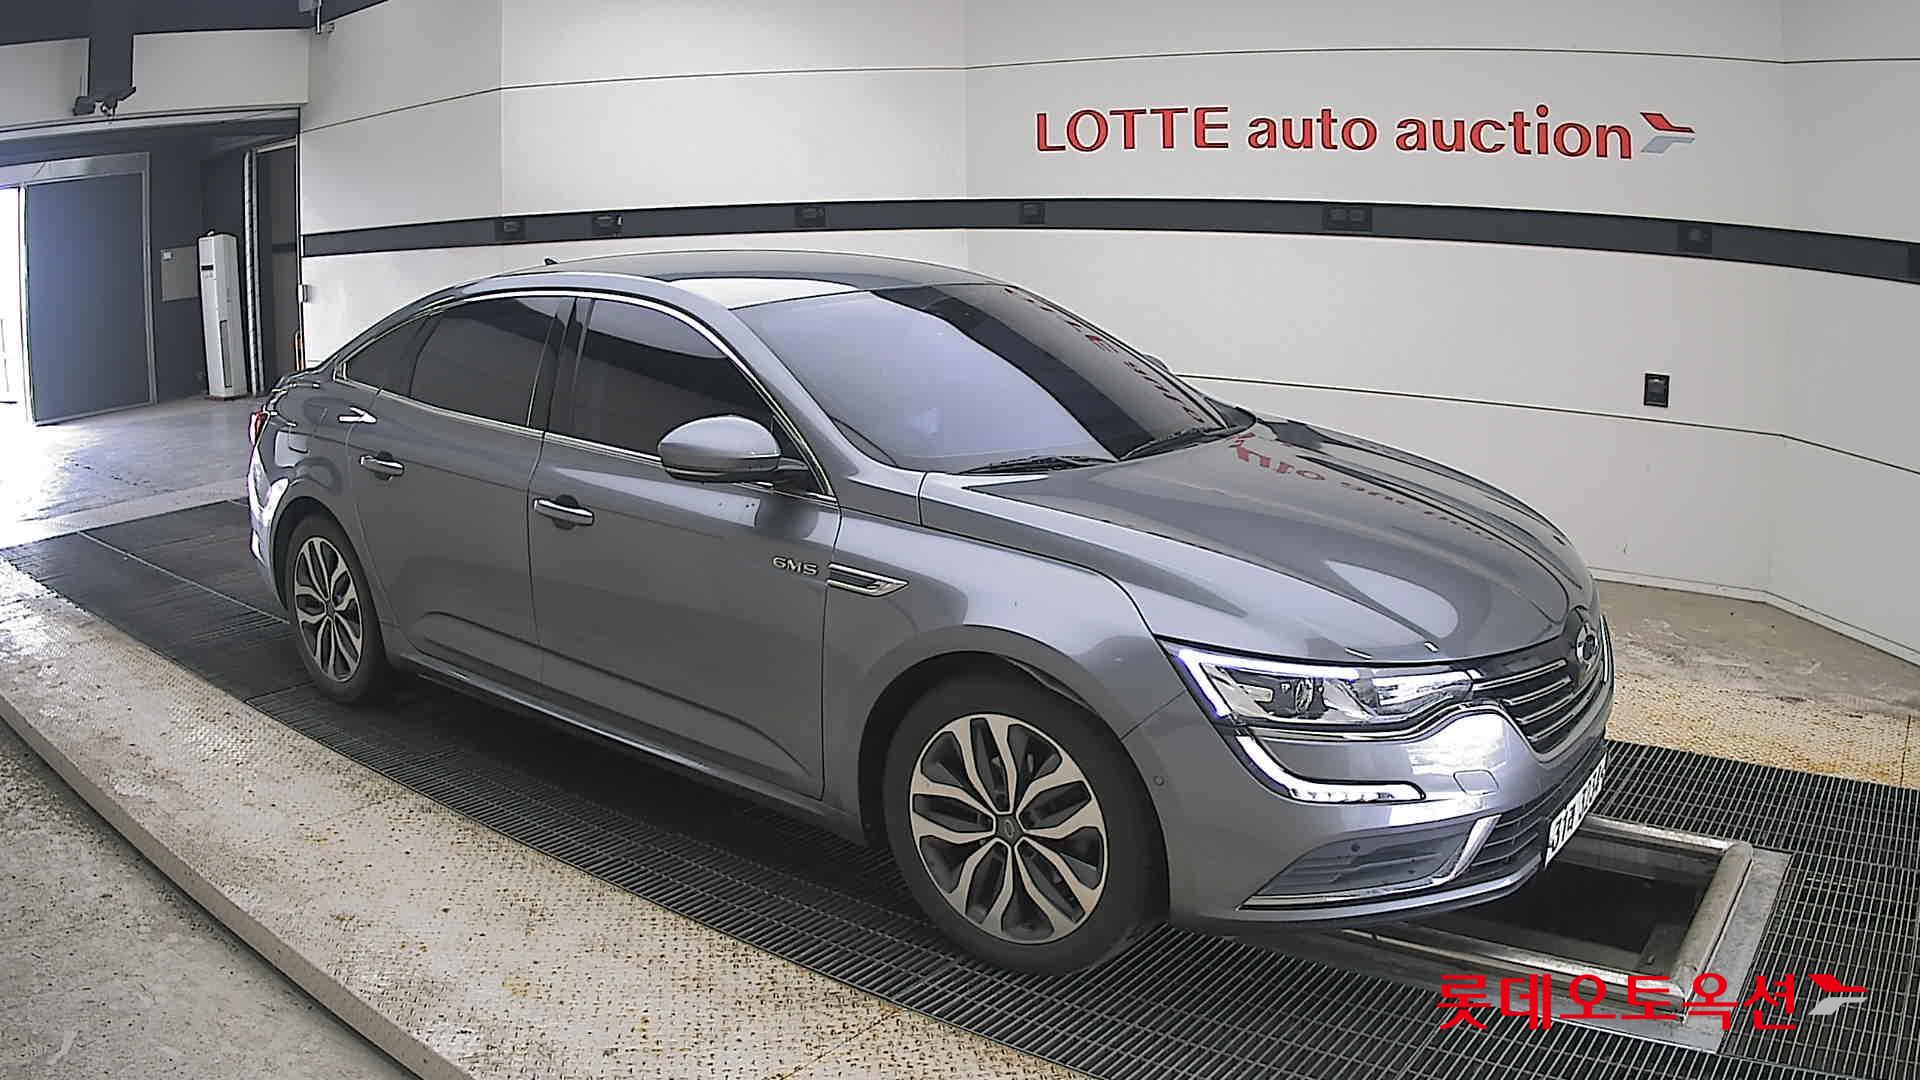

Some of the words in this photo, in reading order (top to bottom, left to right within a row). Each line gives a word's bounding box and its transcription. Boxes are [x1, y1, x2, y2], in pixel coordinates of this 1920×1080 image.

[1036, 106, 1228, 152] LOTTE
[1247, 108, 1379, 151] auto
[1396, 104, 1634, 159] auction
